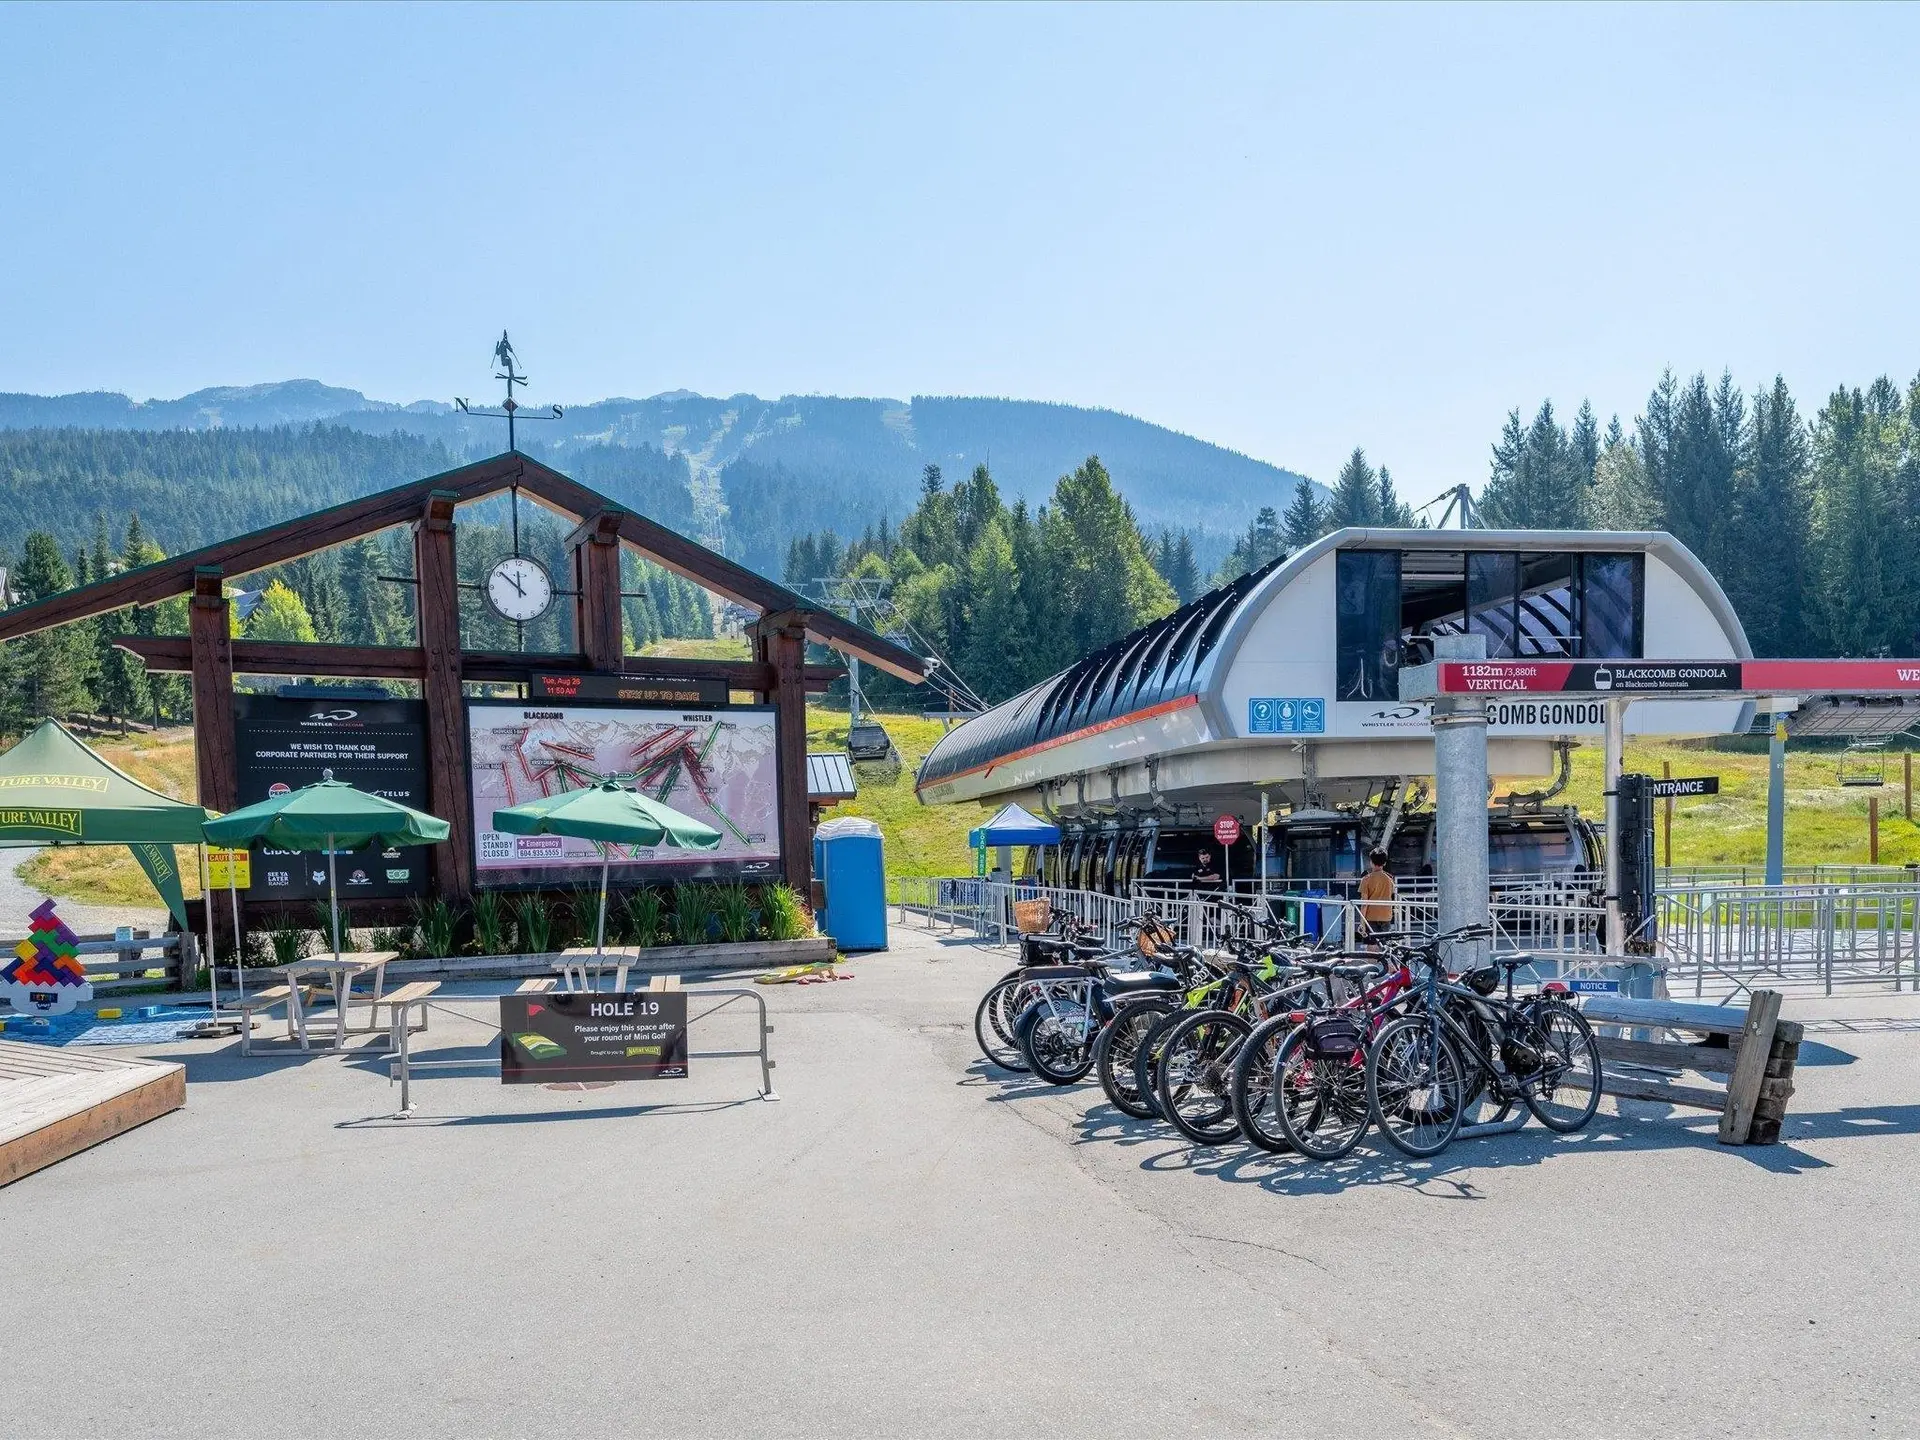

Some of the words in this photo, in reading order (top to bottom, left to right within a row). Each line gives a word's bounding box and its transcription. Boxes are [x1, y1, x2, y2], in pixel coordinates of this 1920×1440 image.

[454, 397, 469, 413] N
[553, 404, 563, 419] S
[1462, 665, 1503, 676] 1182m
[1616, 669, 1675, 678] BLACKCOMB
[1678, 669, 1727, 678] GONDOLA
[1466, 680, 1527, 690] VERTICAL
[565, 687, 577, 695] AM
[617, 690, 643, 699] STAY
[644, 691, 659, 700] UP
[660, 691, 673, 700] TO
[524, 711, 564, 720] BLACKCOMB
[682, 714, 712, 722] WHISTLER
[43, 777, 104, 791] VALLEY
[28, 812, 77, 831] VALLEY
[1219, 820, 1235, 829] STOP
[482, 833, 500, 841] OPEN
[526, 839, 560, 848] Emergency
[482, 850, 509, 858] CLOSED
[519, 849, 560, 857] 604.935.5555
[149, 848, 170, 878] VALLEY
[1580, 982, 1607, 991] NOTICE
[591, 1003, 634, 1016] HOLE
[641, 1002, 659, 1015] 19
[575, 1025, 599, 1033] Please
[600, 1025, 620, 1034] enjoy
[621, 1024, 635, 1032] this
[636, 1025, 657, 1034] space
[659, 1023, 675, 1031] after
[584, 1035, 600, 1043] your
[624, 1033, 632, 1041] of
[634, 1032, 650, 1040] Mini
